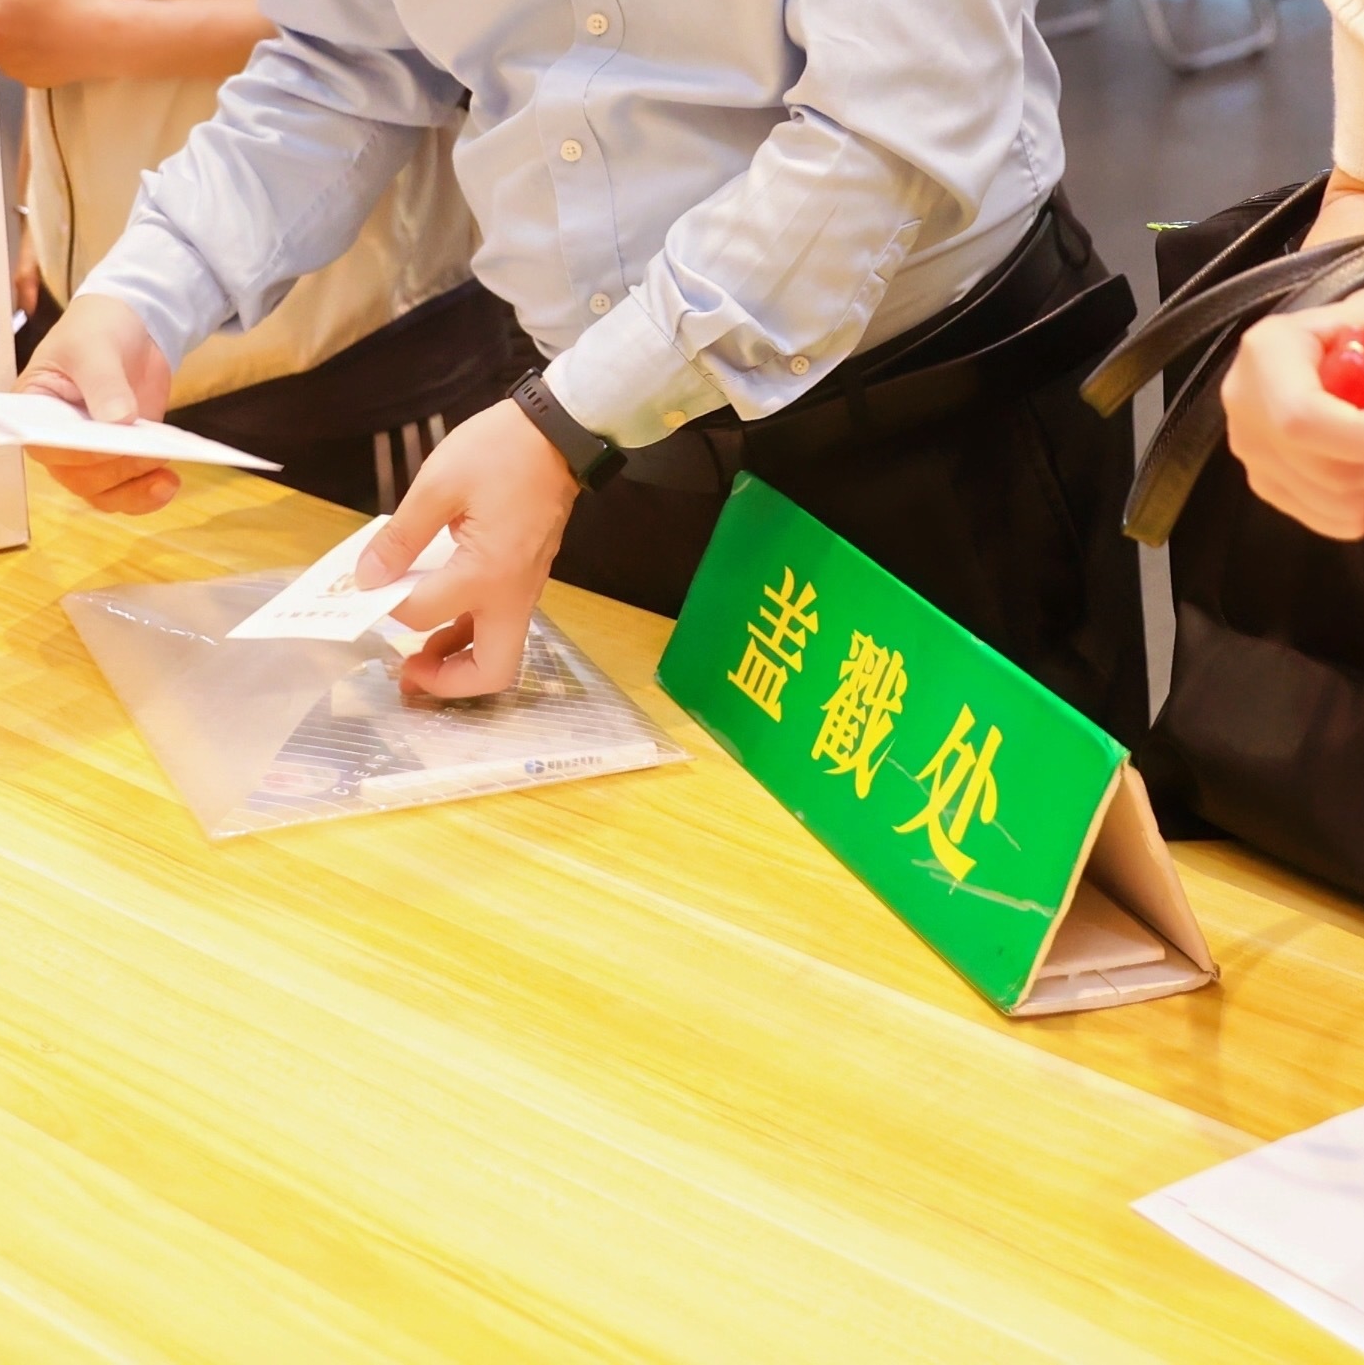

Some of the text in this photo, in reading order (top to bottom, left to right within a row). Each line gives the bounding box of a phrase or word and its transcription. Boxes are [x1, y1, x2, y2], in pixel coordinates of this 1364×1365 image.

[332, 706, 464, 796] CLEAR HOLDER
[727, 565, 1003, 883] 盖戳处
